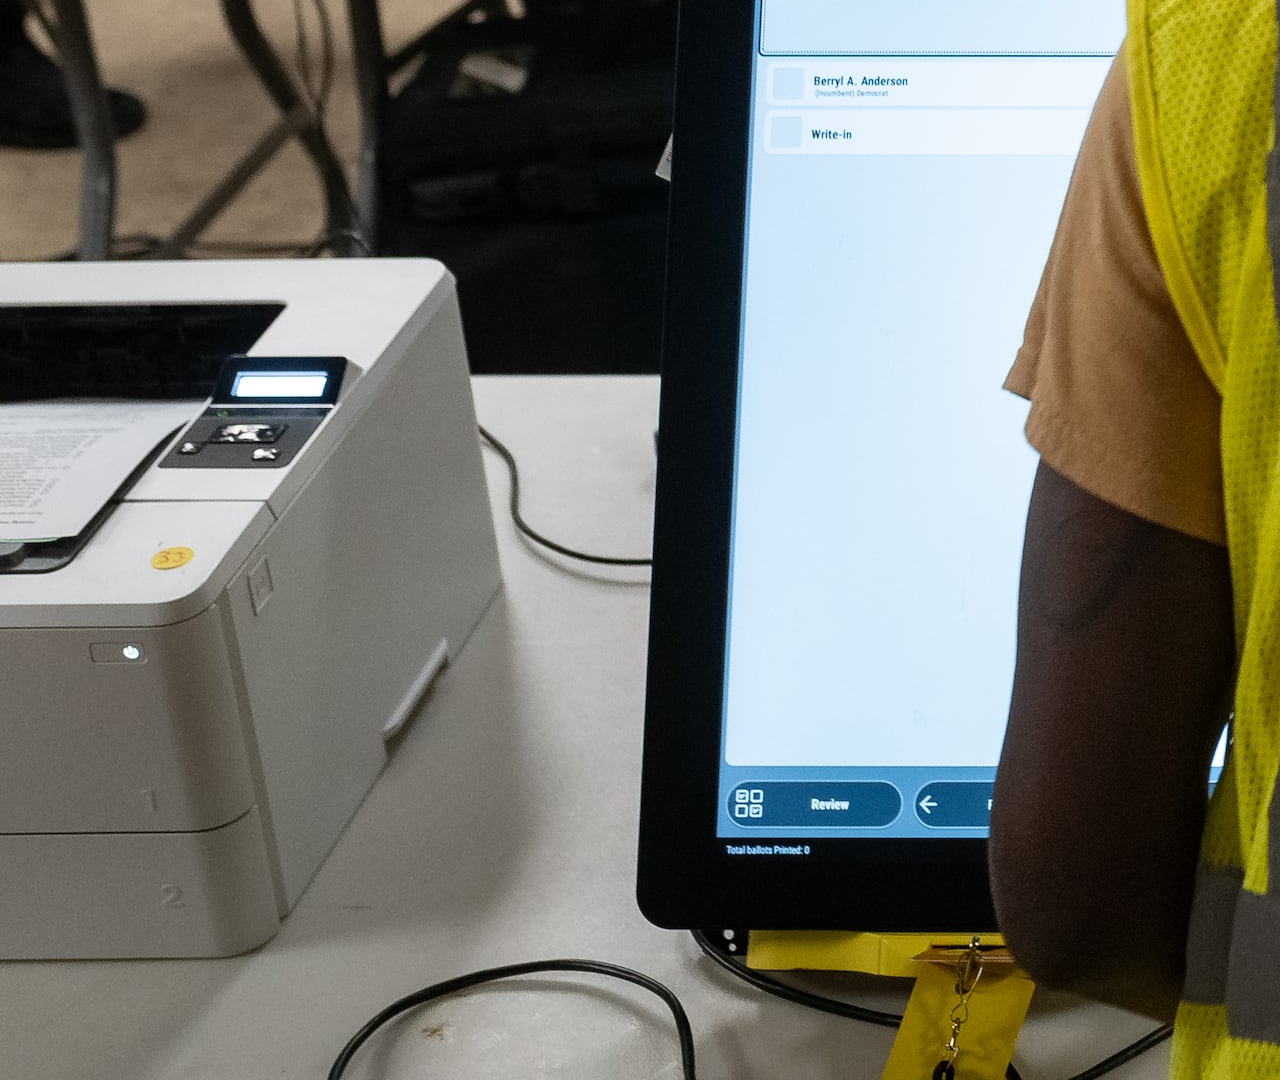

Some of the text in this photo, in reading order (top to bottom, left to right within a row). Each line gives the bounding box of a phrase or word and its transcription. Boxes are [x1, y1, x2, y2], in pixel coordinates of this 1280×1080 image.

[814, 76, 908, 88] Berryl A. Anderson
[815, 90, 855, 98] (Incumbent)
[811, 129, 852, 139] Write-in
[811, 798, 849, 811] Review
[726, 845, 810, 855] Total ballots Printed: 0
